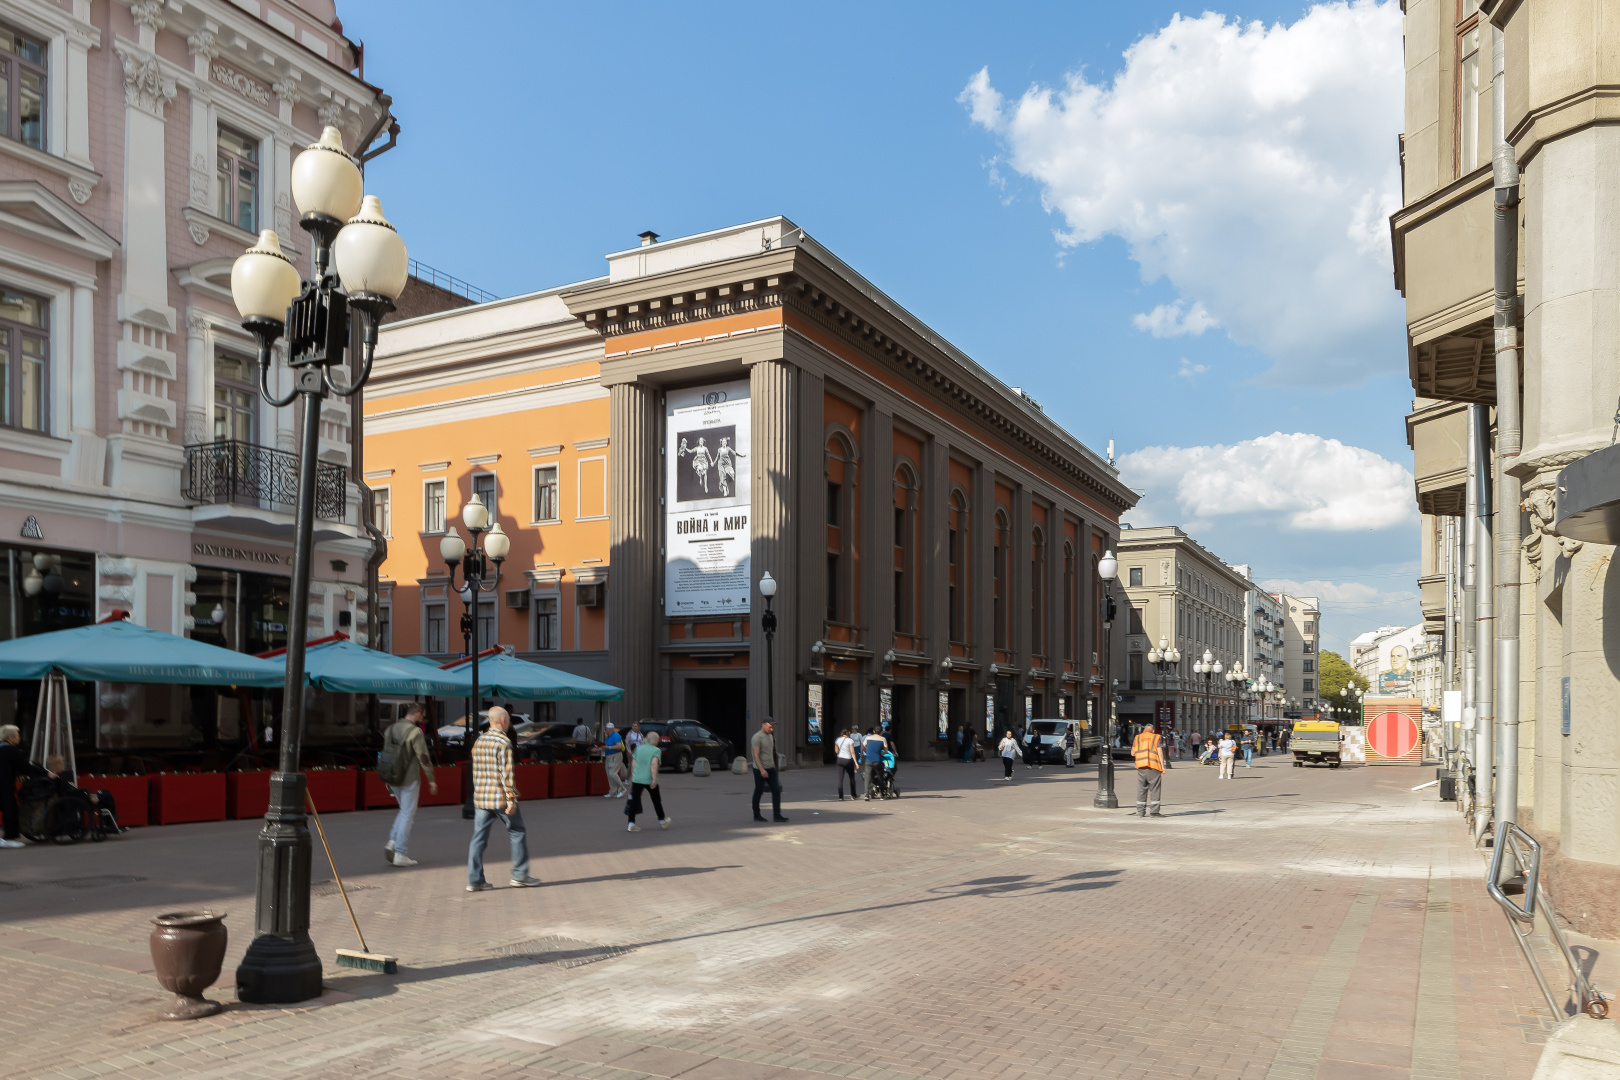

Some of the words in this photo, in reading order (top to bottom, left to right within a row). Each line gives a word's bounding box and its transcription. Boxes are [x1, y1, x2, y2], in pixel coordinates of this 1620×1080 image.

[677, 517, 708, 534] ВОЙНА
[724, 515, 747, 531] МИР
[194, 543, 248, 559] SIXTEEN
[249, 550, 280, 564] TONS
[129, 665, 222, 679] ШЕСТНАДЦАТЬ
[224, 669, 256, 680] ТОНН
